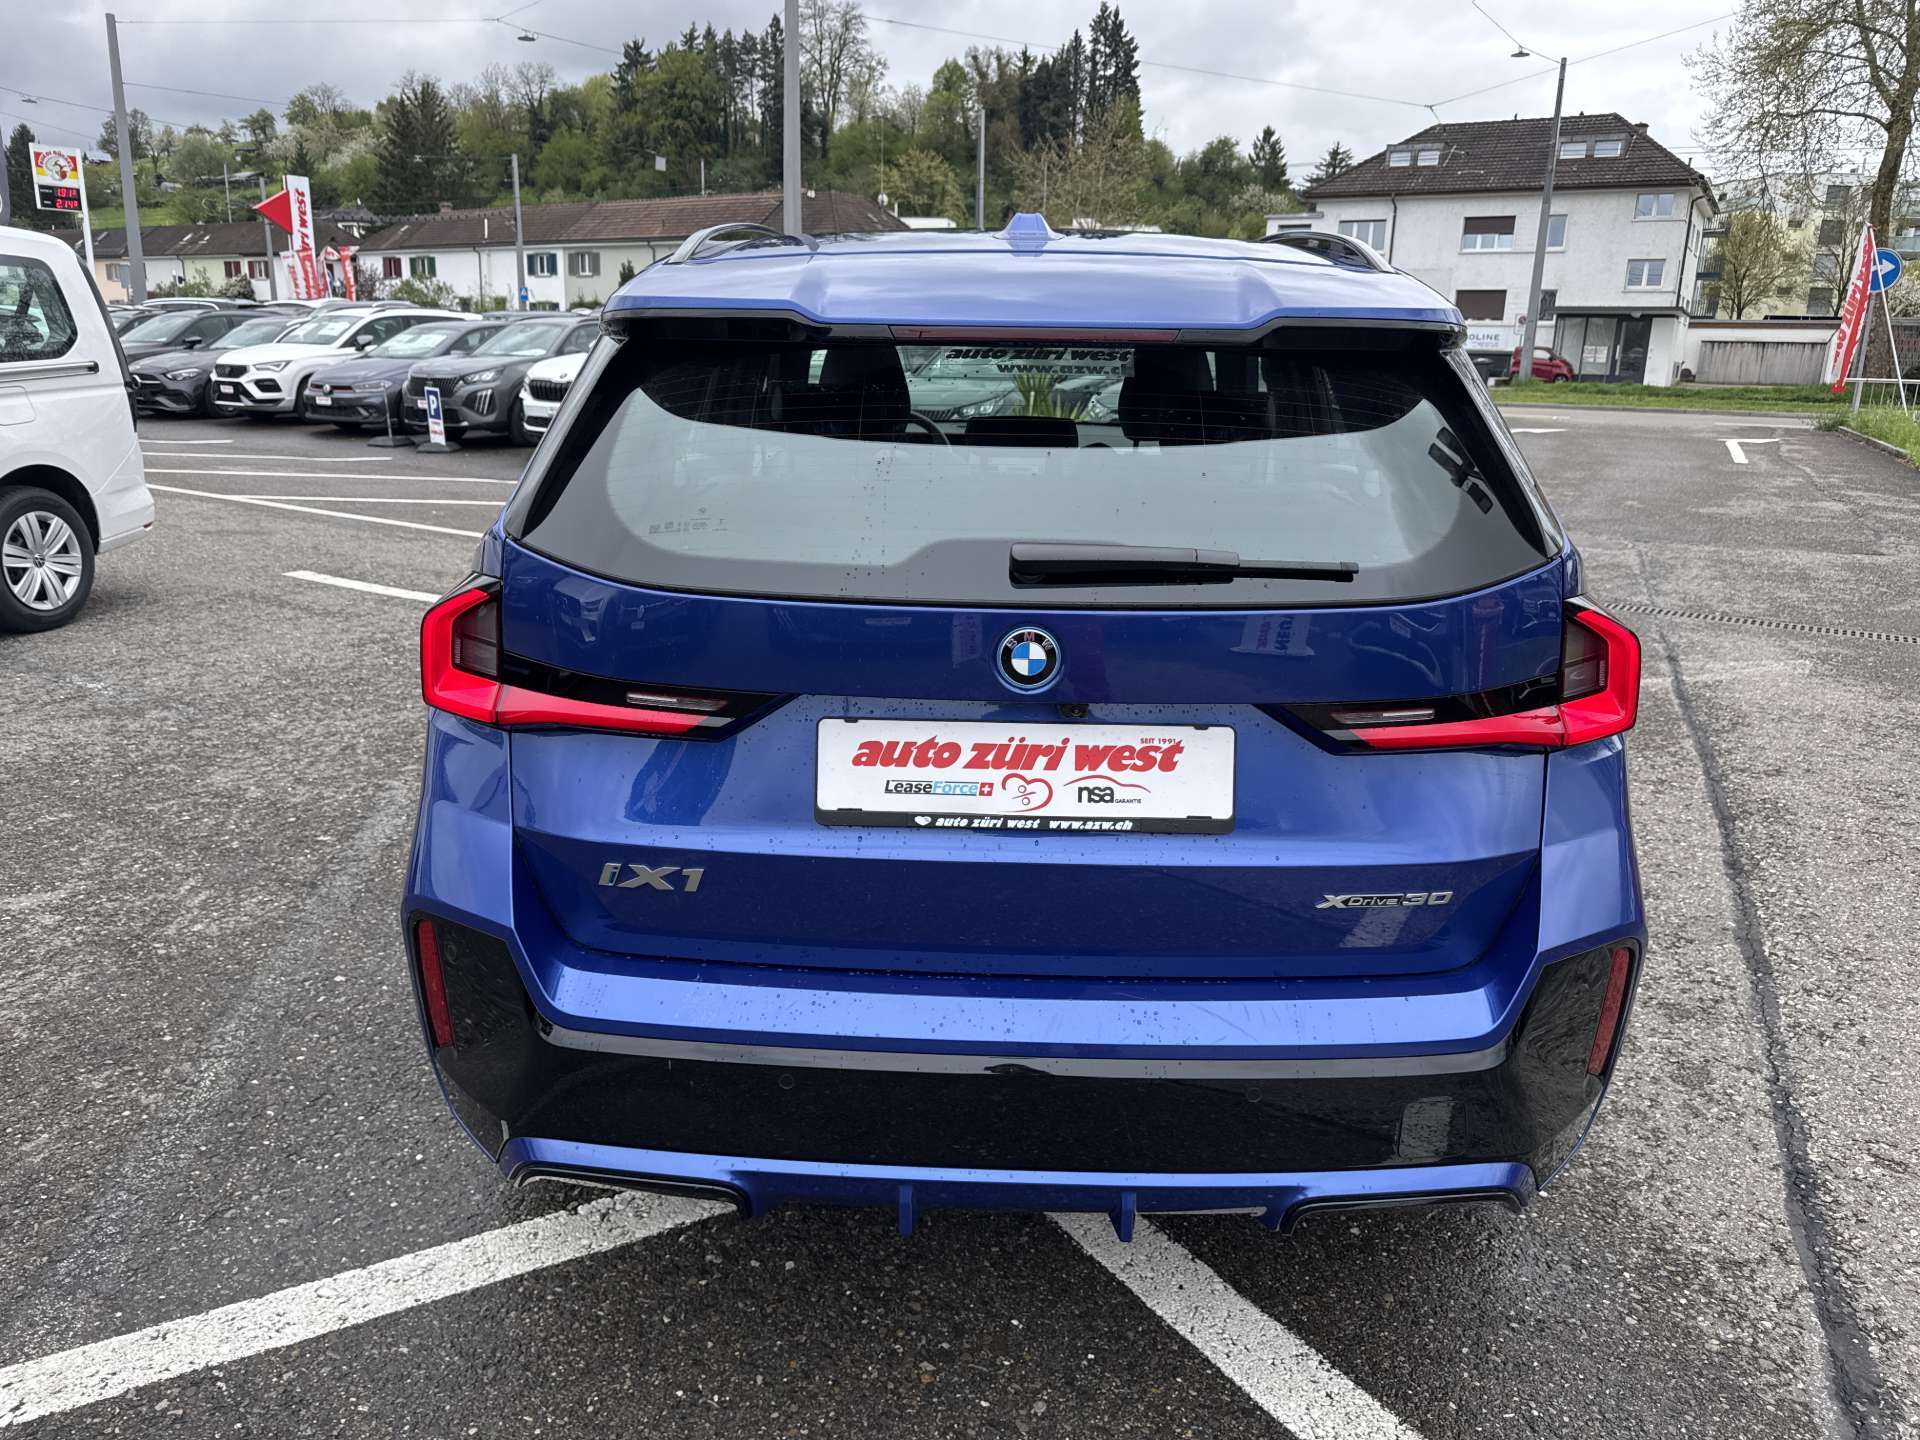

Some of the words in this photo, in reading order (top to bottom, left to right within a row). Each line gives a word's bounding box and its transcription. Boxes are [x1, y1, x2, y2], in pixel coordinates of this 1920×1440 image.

[295, 188, 308, 228] west
[429, 394, 437, 416] P
[1005, 631, 1053, 651] BMW
[851, 735, 962, 769] auto
[962, 736, 1070, 771] züri
[1074, 739, 1185, 773] west
[884, 780, 978, 795] LeaseForce
[1077, 786, 1114, 803] nsa
[935, 817, 969, 827] auto
[972, 816, 1003, 828] züri
[1007, 818, 1040, 829] west
[1049, 819, 1133, 831] www.azw.ch
